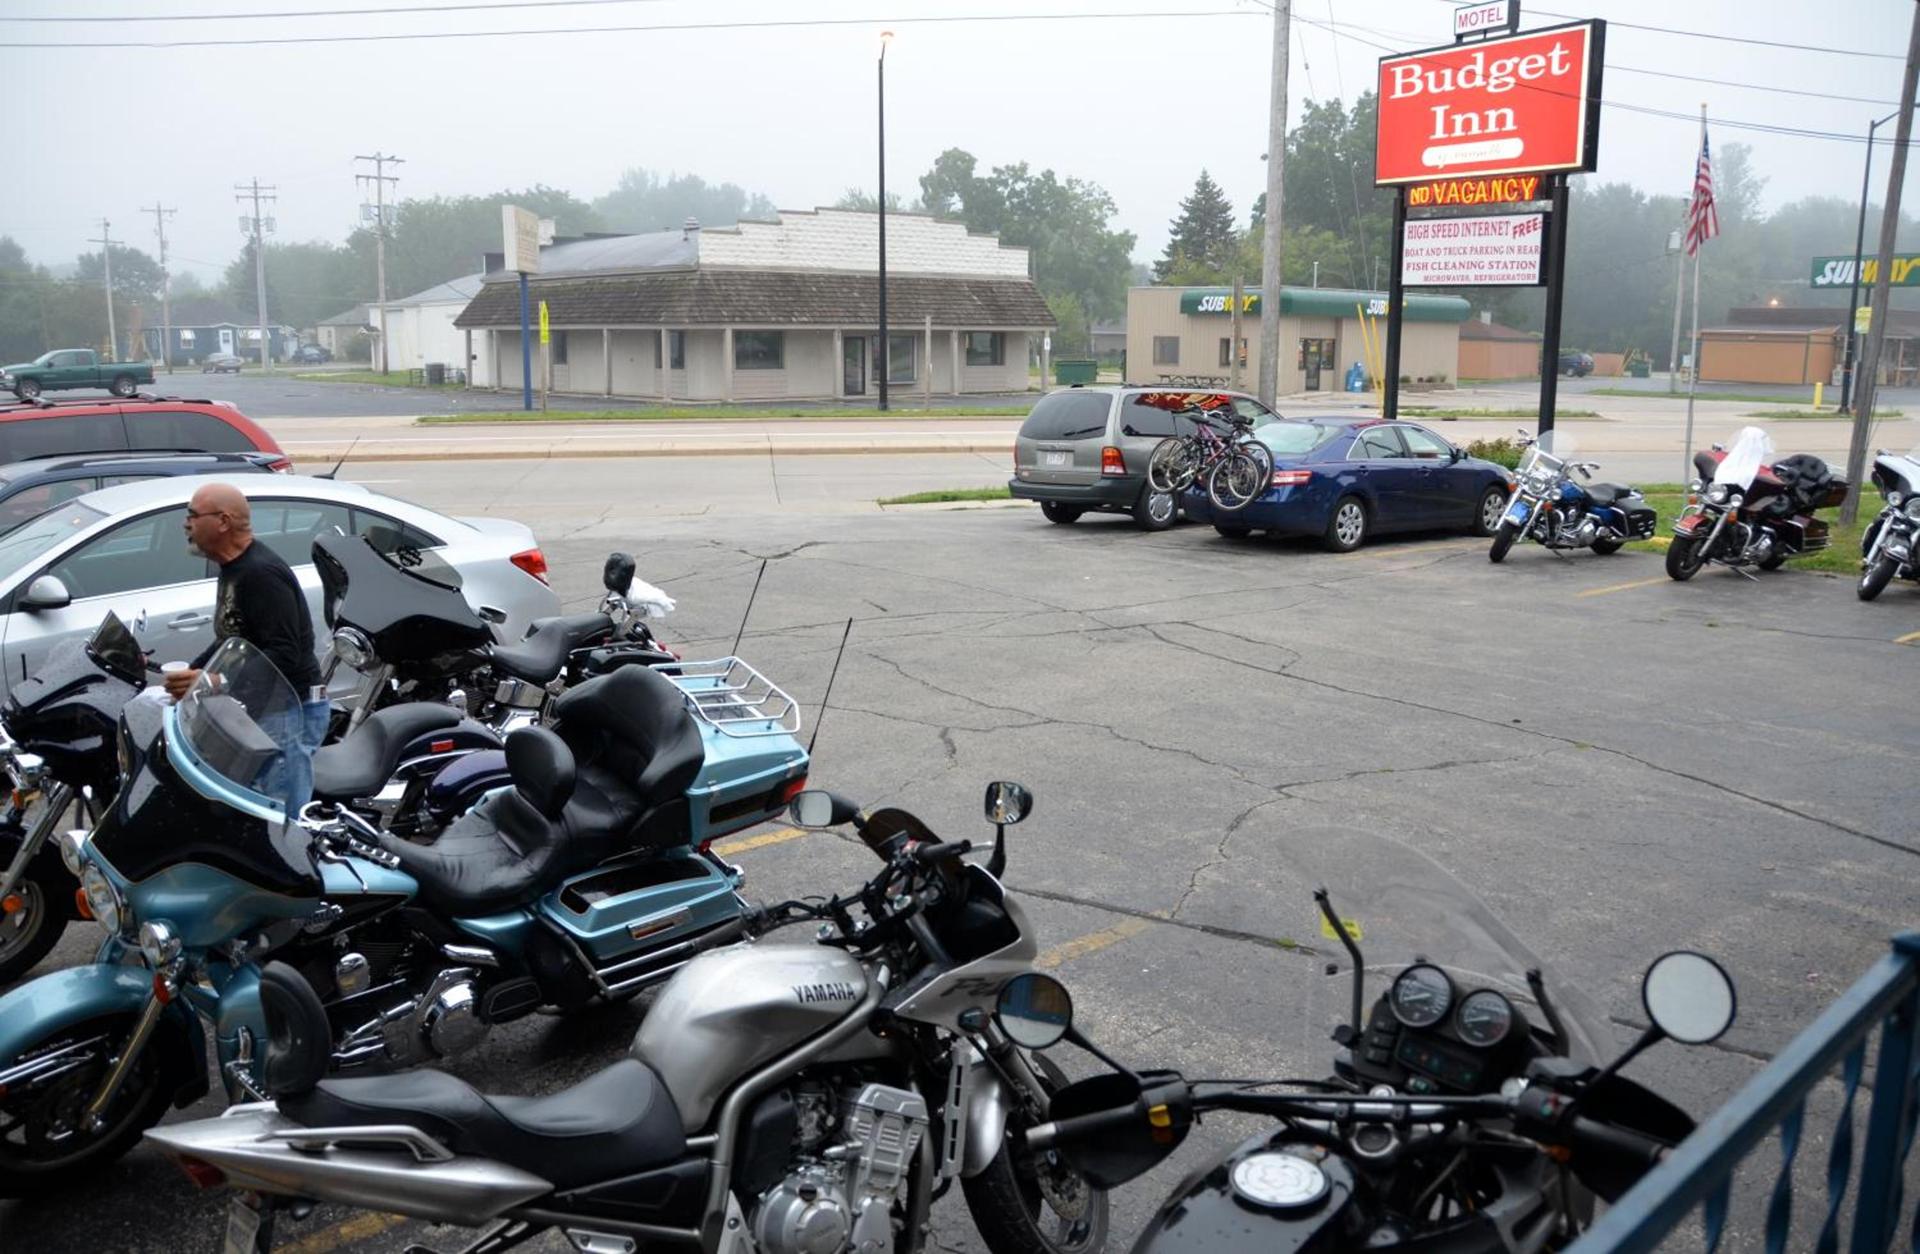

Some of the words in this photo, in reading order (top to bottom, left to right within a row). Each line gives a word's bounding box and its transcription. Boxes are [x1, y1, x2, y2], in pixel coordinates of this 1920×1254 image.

[1457, 8, 1503, 28] MOTEL
[1389, 41, 1571, 99] Budget
[1429, 104, 1517, 140] Inn
[1410, 186, 1430, 206] NO
[1407, 224, 1429, 240] HIGH
[1431, 222, 1460, 239] SPEED
[1461, 220, 1511, 238] INTERNET
[1405, 247, 1425, 258] BOAT
[1425, 247, 1442, 257] AND
[1443, 246, 1468, 256] TRUCK
[1469, 245, 1504, 256] PARKING
[1505, 245, 1516, 255] IN
[1517, 244, 1541, 255] REAR
[1406, 262, 1429, 271] FISH
[1430, 261, 1485, 271] CLEANING
[1487, 260, 1537, 270] STATION
[1815, 257, 1920, 286] SUBWY
[1197, 294, 1258, 312] SUBWY
[791, 982, 857, 1003] YAMAHA
